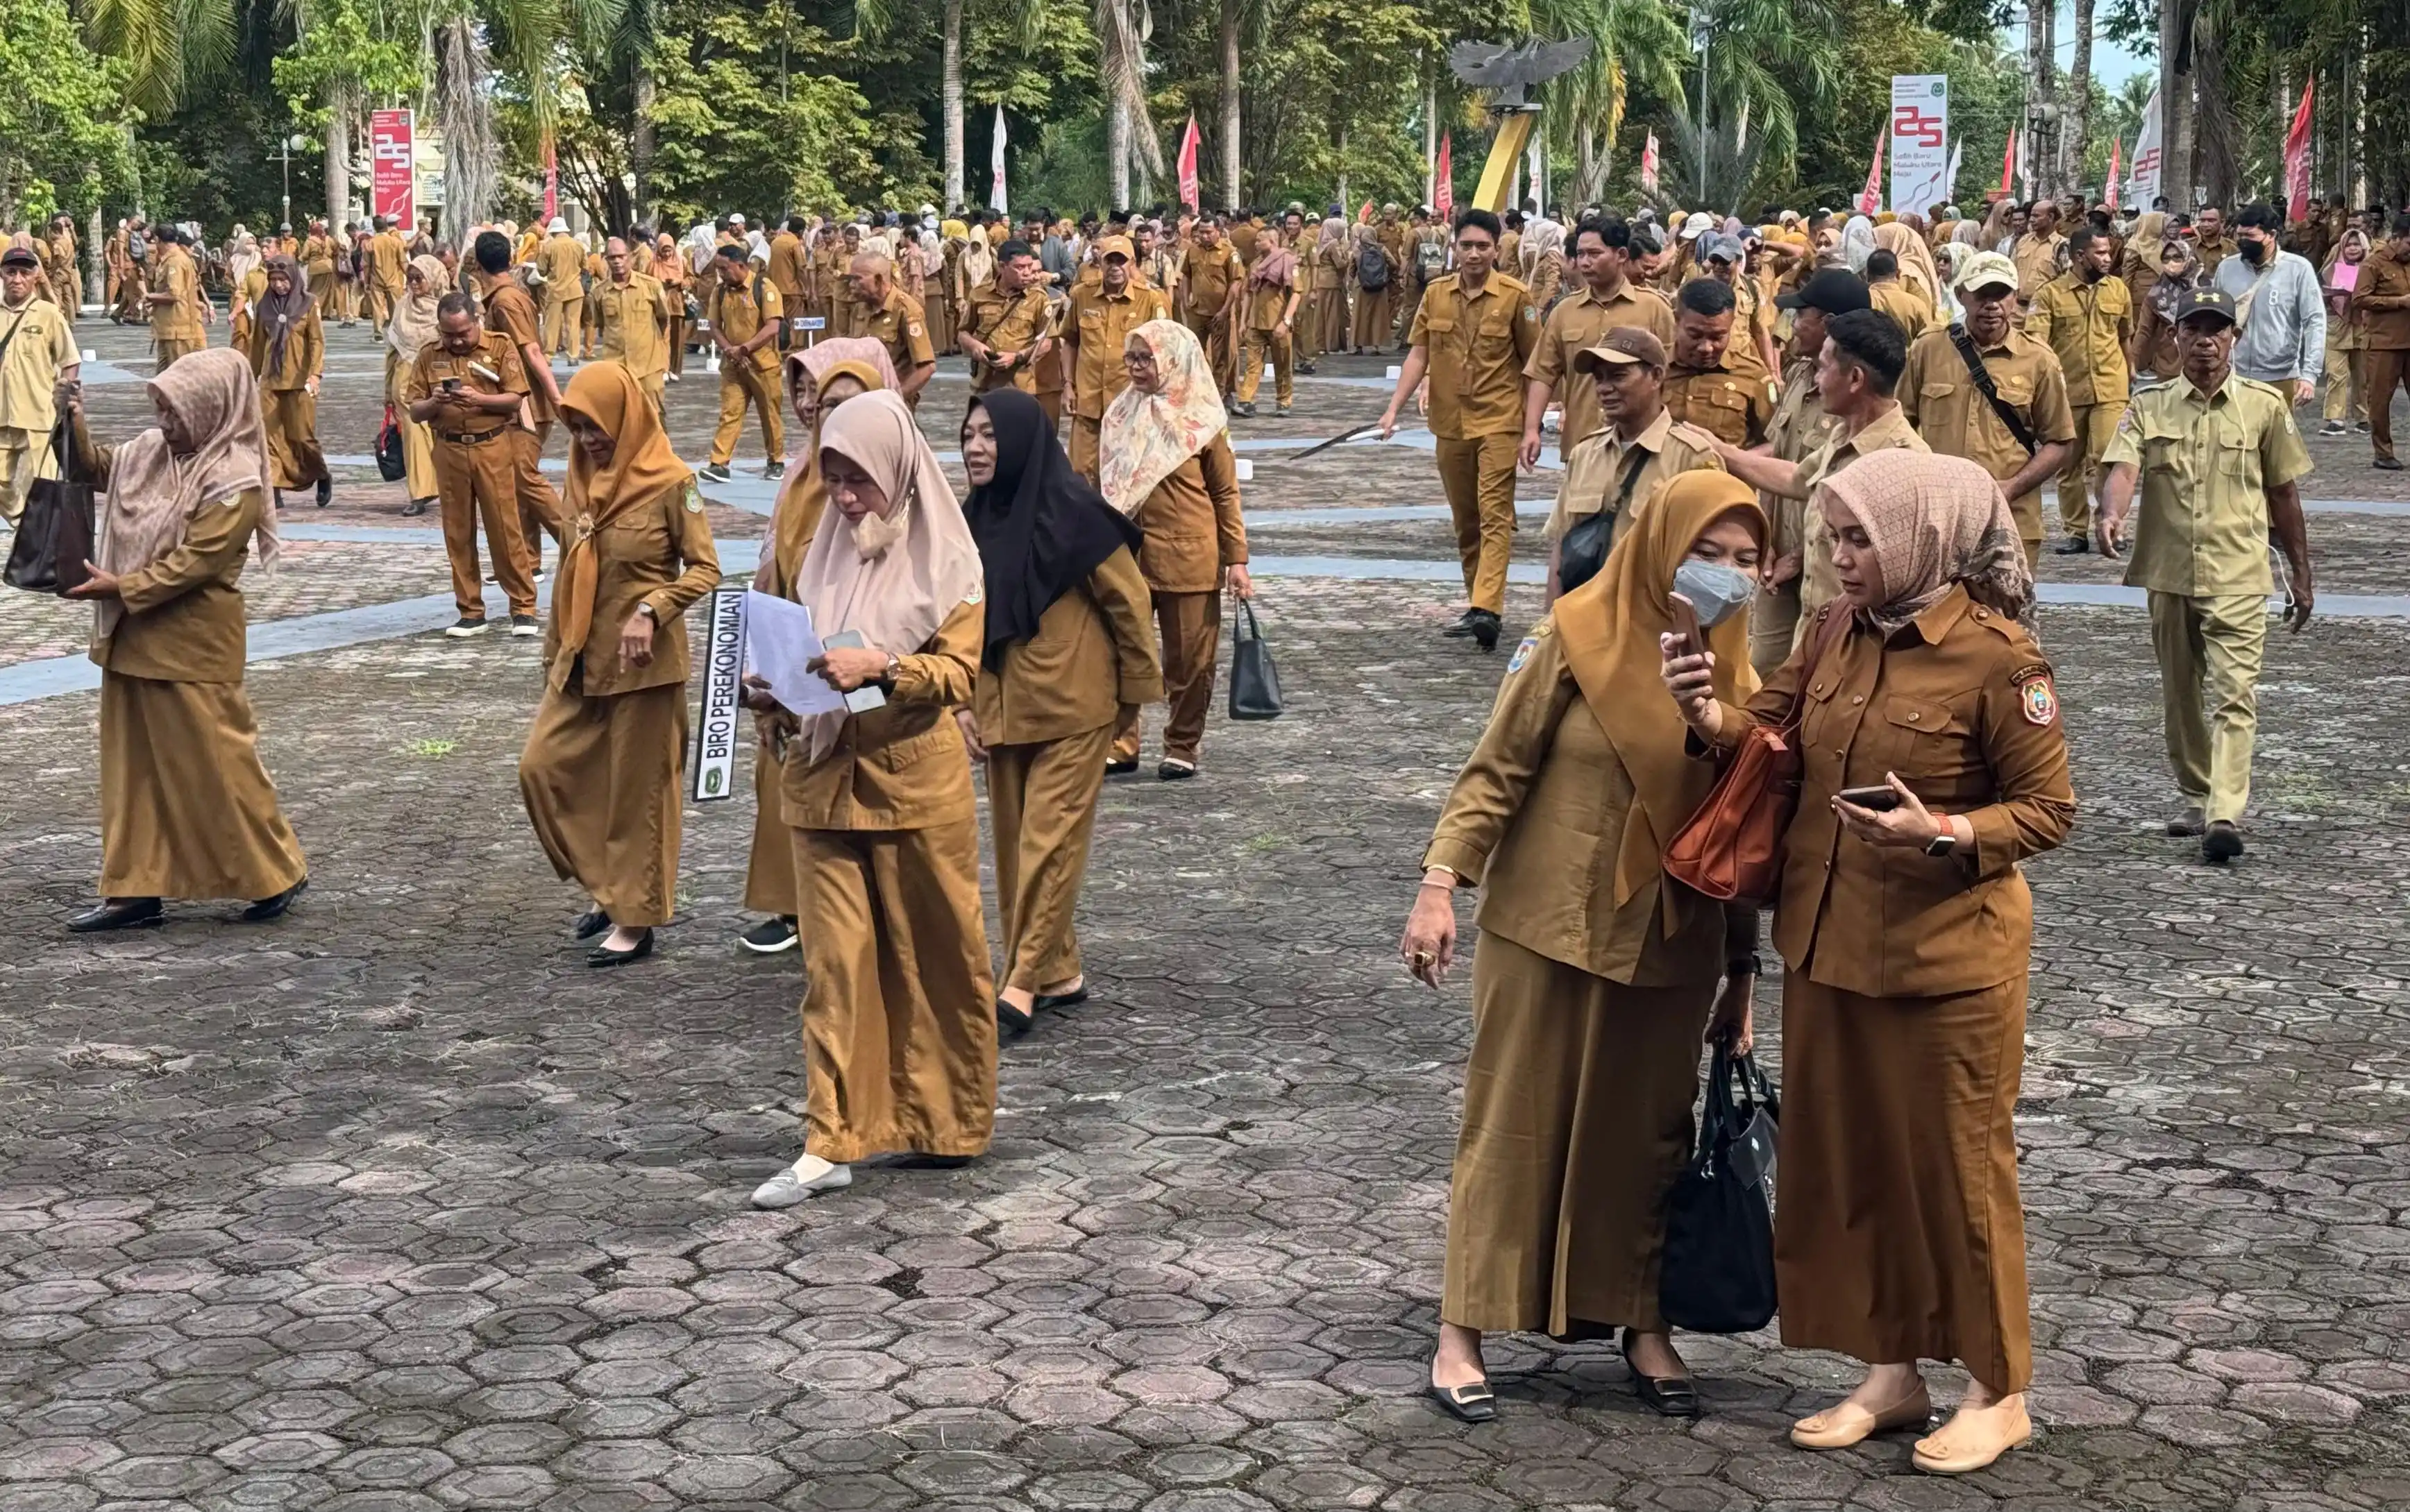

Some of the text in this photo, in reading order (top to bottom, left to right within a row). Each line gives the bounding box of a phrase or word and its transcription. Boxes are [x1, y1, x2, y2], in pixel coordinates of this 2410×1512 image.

[1894, 105, 1943, 147] 25
[376, 133, 410, 169] 25
[2269, 289, 2279, 305] 8
[707, 593, 743, 758] BIRO PEREKONOMIAN
